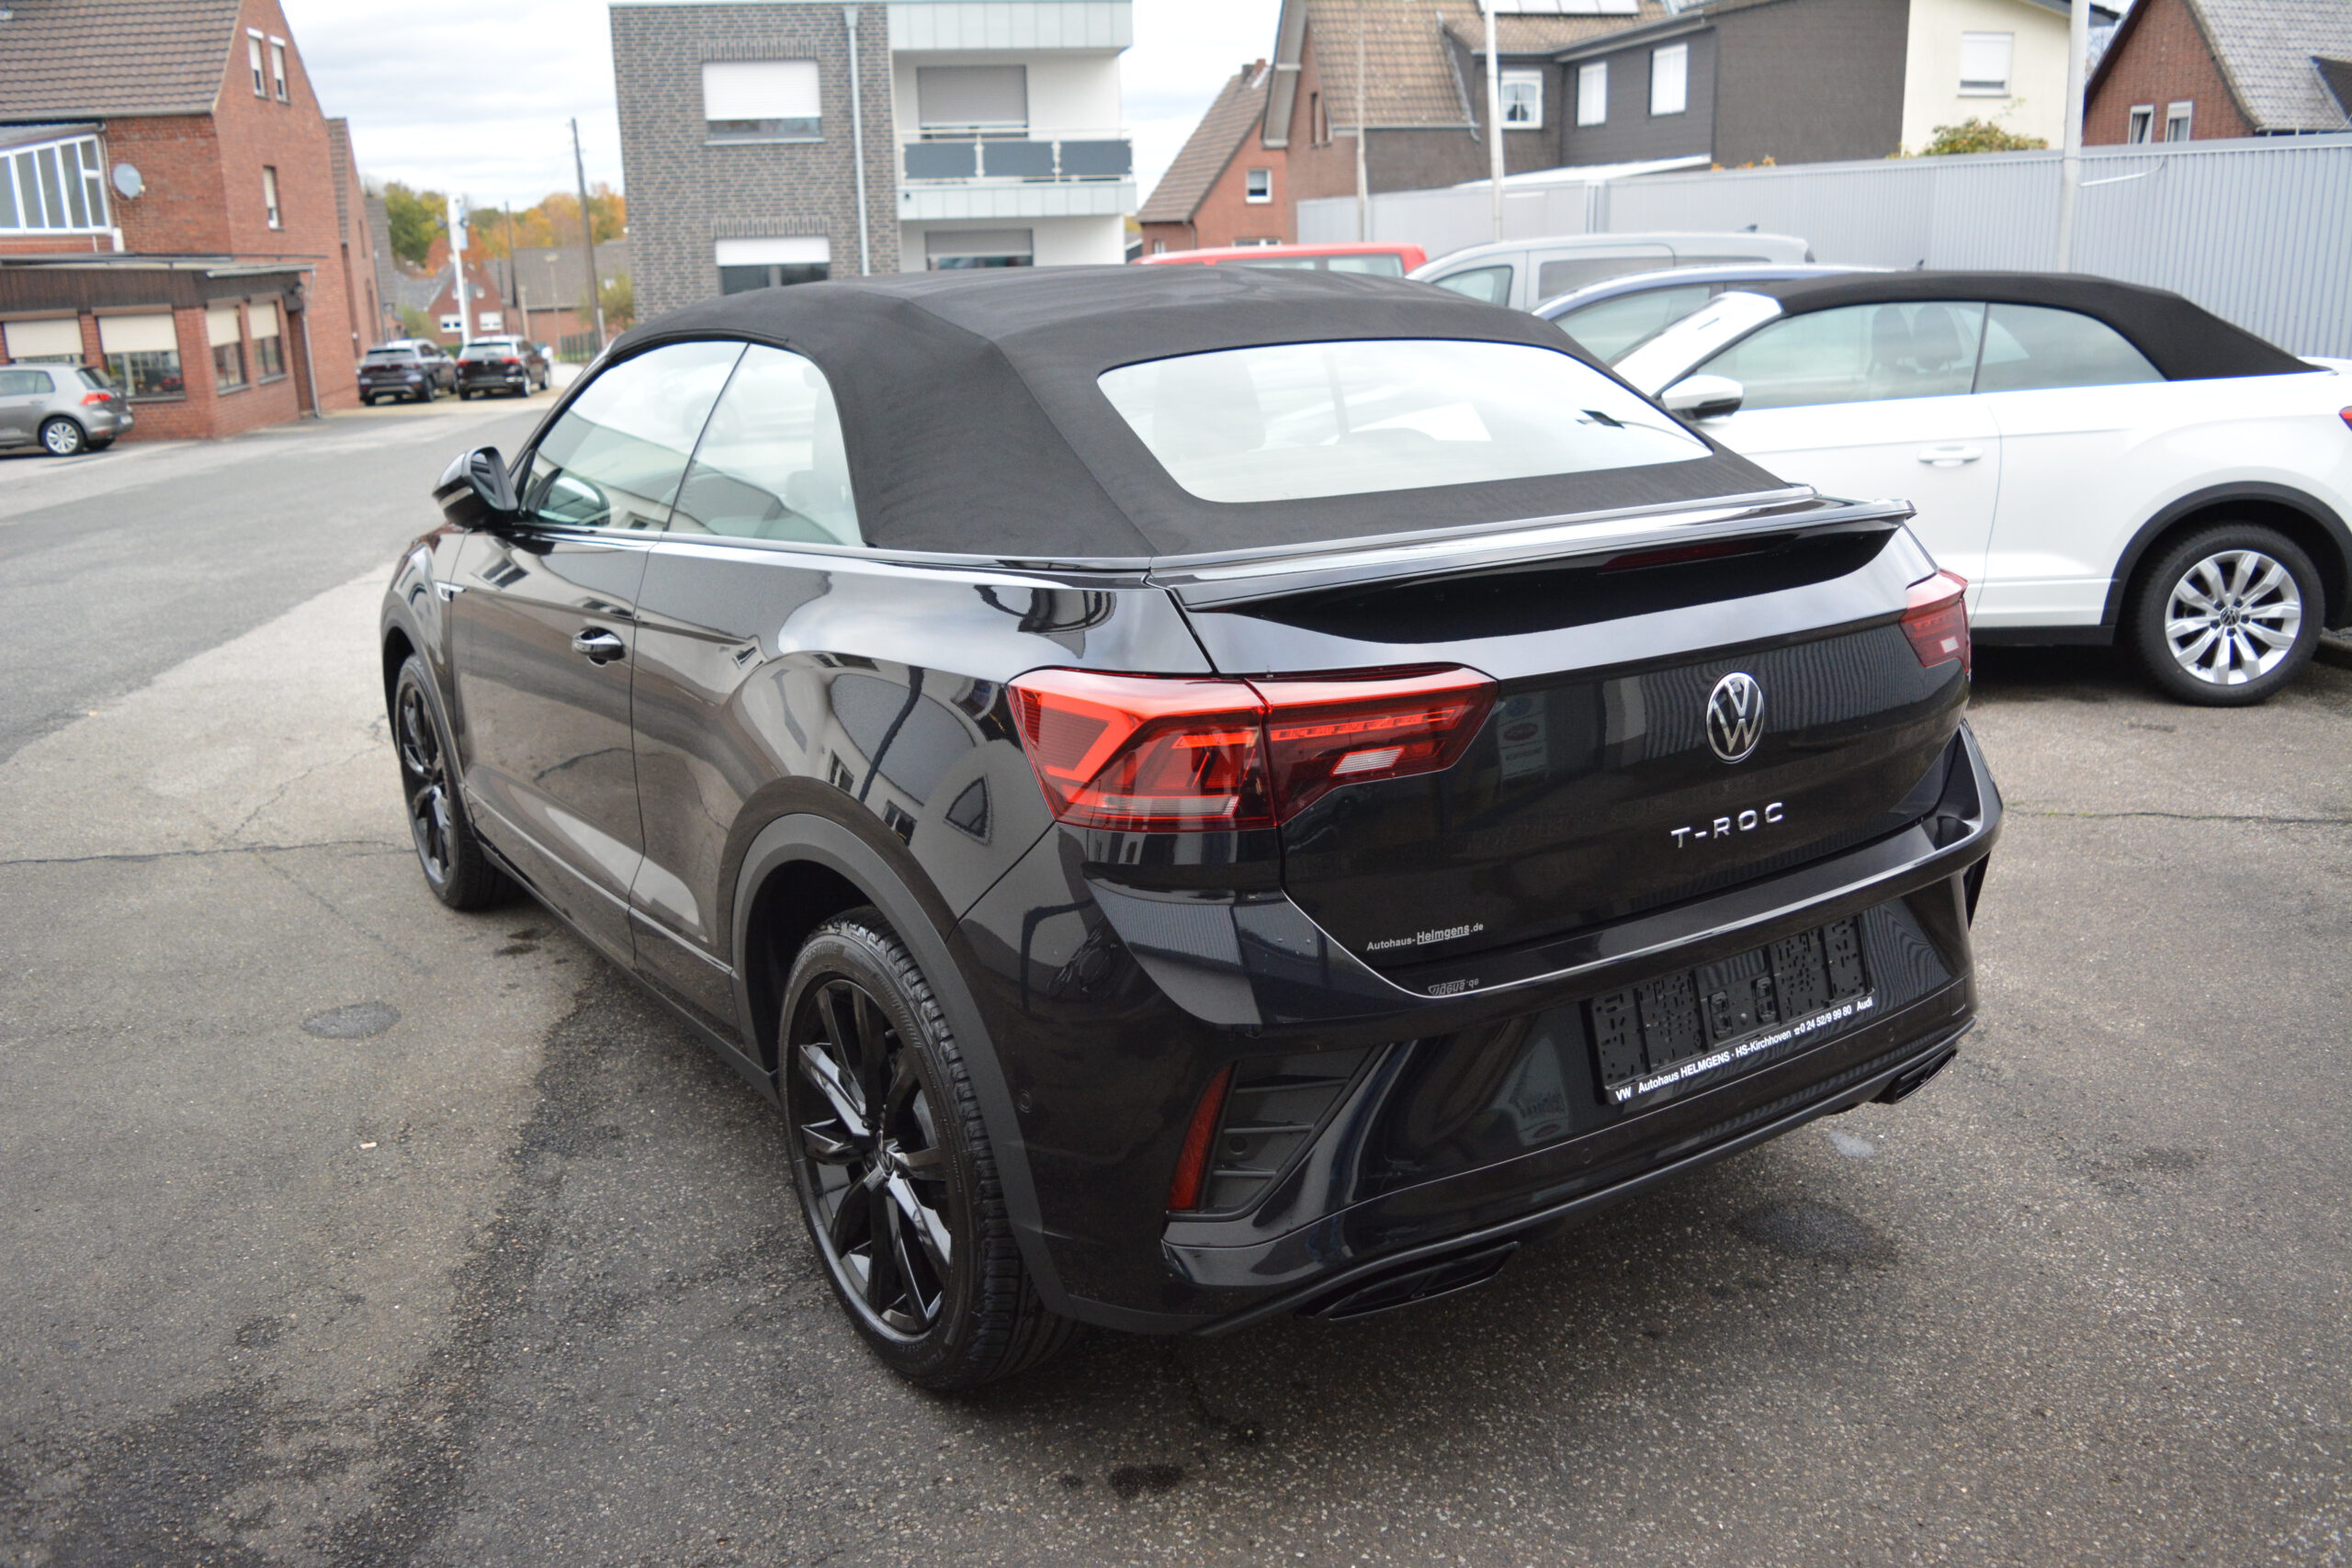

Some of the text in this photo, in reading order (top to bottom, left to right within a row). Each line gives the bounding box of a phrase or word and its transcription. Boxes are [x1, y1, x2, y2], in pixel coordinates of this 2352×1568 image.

[1670, 802, 1783, 849] T-ROC
[1615, 1087, 1632, 1101] VW
[1638, 1071, 1679, 1094] Autohaus
[1680, 1051, 1730, 1077] HELMGENS
[1736, 1030, 1792, 1058] HS-Kirchhoven
[1856, 997, 1873, 1011] Audi
